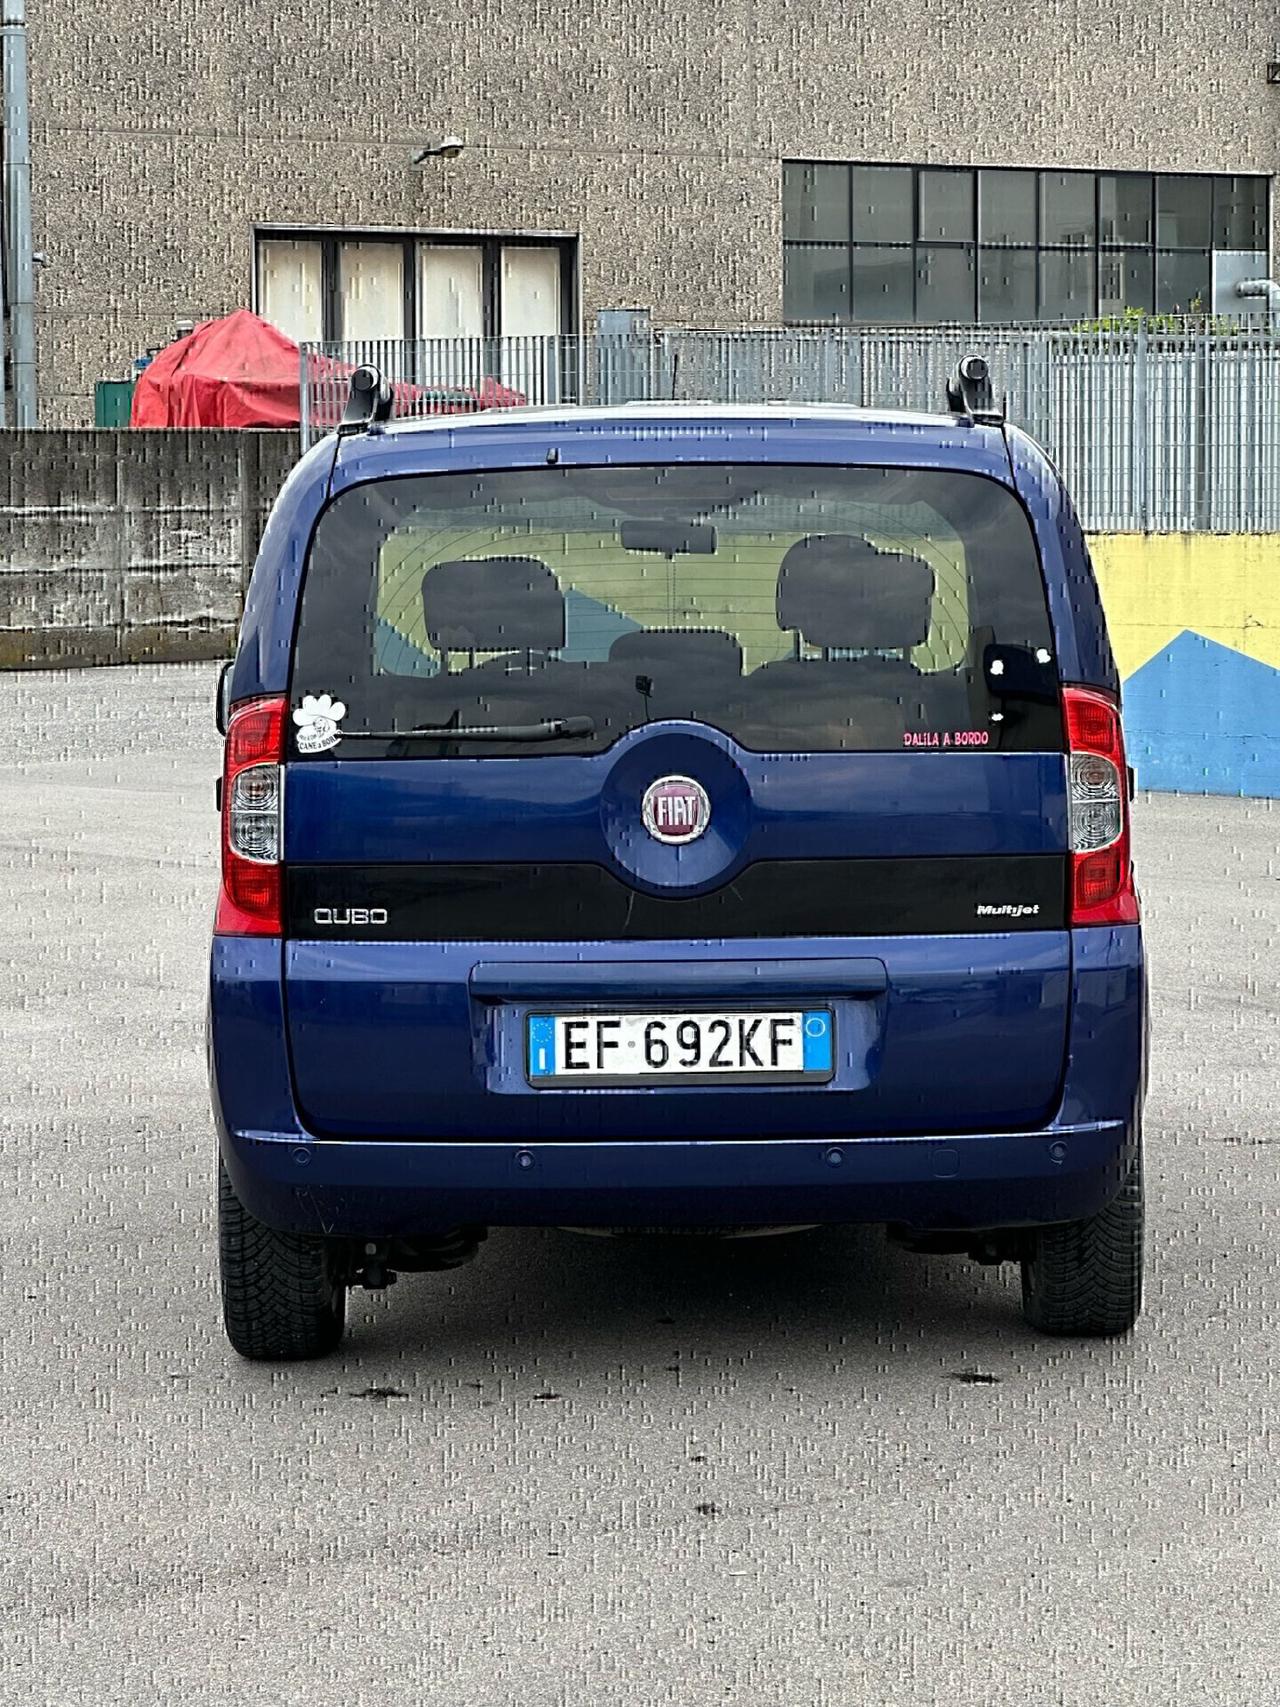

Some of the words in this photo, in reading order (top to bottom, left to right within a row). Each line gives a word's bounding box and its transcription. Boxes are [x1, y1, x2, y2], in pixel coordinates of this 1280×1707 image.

[943, 732, 951, 746] A
[954, 731, 989, 745] BORDO
[658, 796, 696, 826] FIAT
[314, 908, 388, 925] QUBO
[977, 904, 1040, 917] Multijet
[564, 1021, 621, 1070] EF
[643, 1017, 796, 1069] 692KF
[539, 1048, 546, 1070] I
